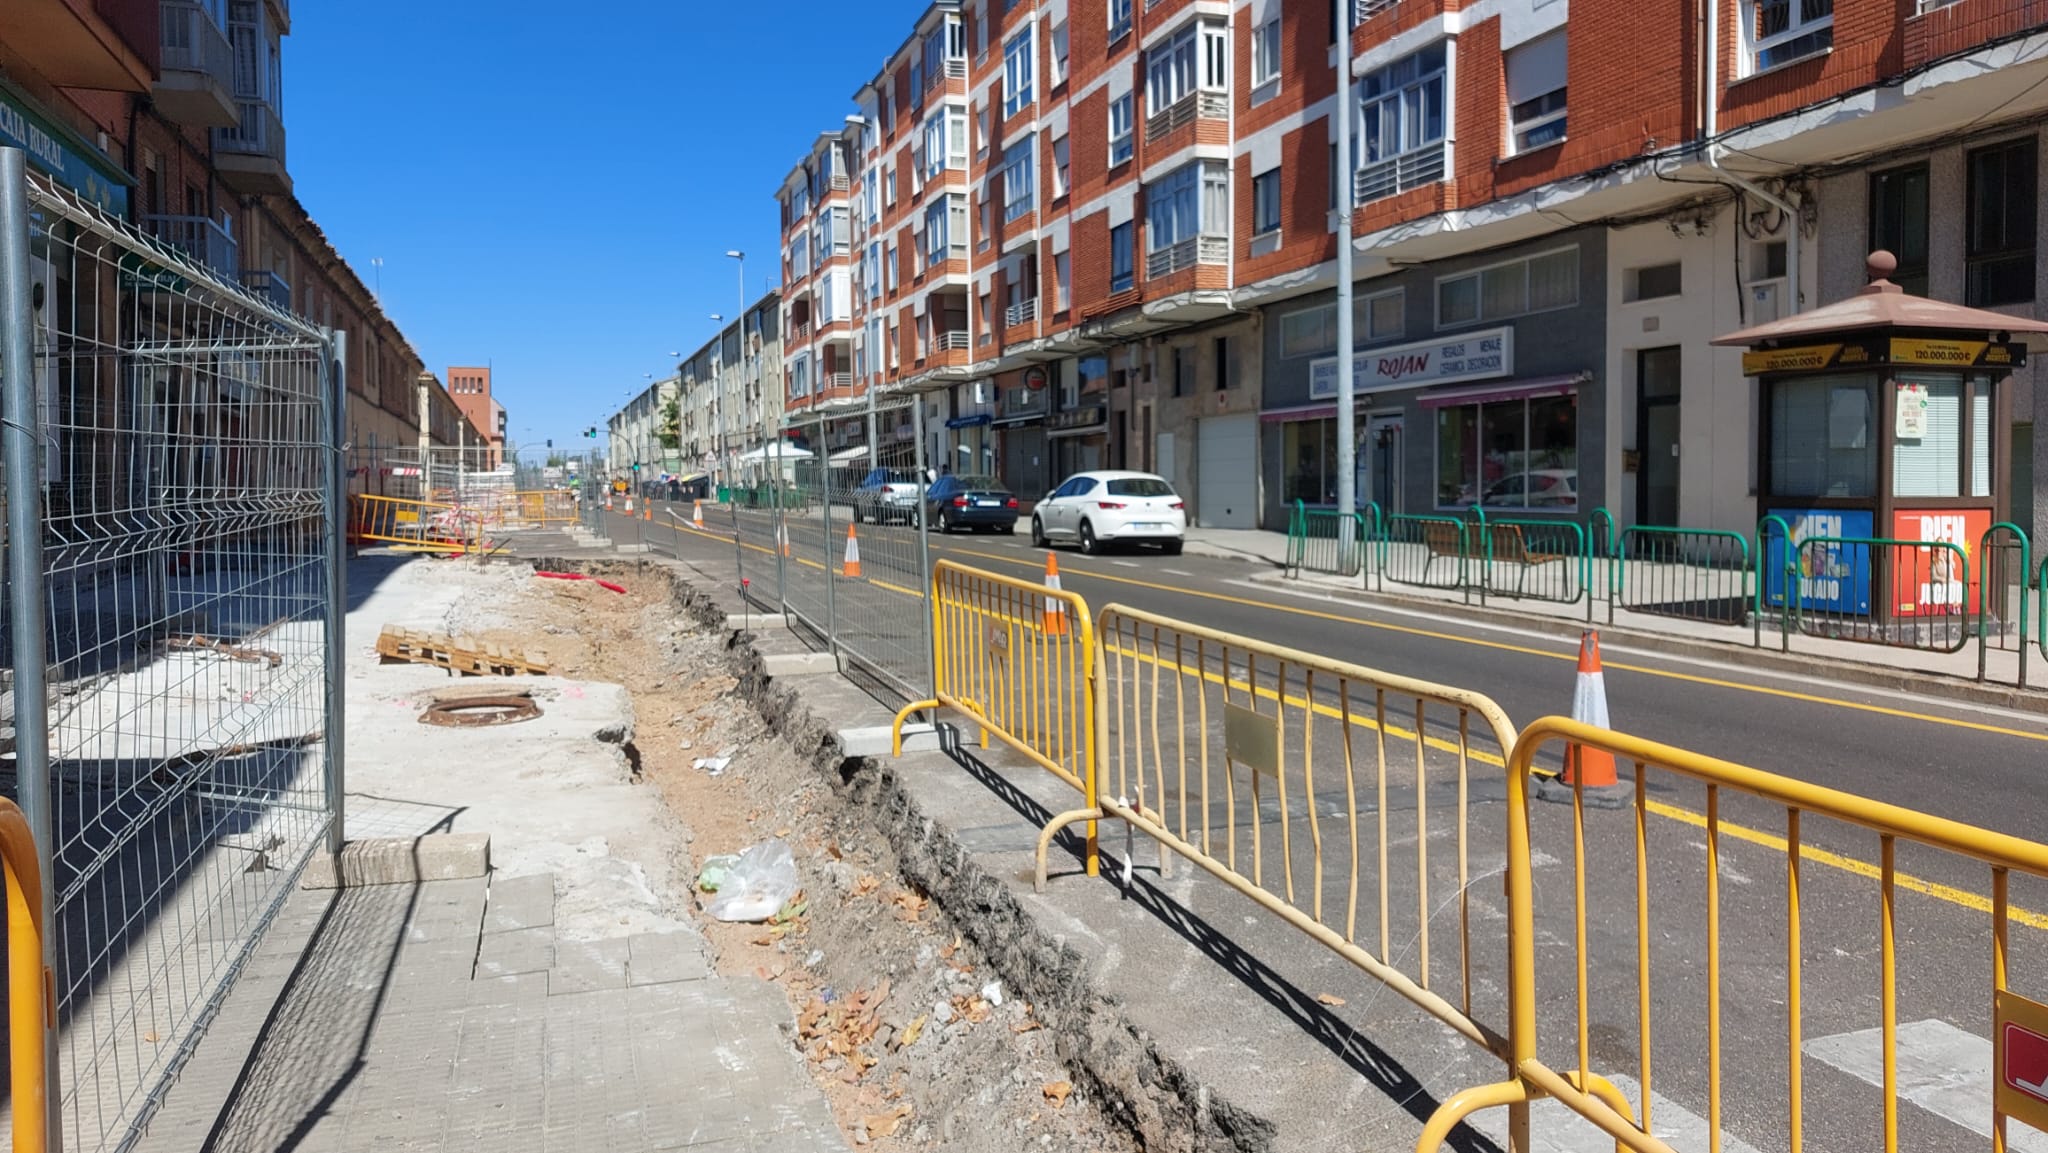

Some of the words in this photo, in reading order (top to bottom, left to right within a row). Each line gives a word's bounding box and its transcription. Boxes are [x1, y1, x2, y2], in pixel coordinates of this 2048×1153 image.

[0, 102, 27, 146] CAJA
[29, 122, 65, 173] RURAL
[1377, 352, 1430, 379] ROJAN
[1920, 515, 1965, 553] BIEN
[1798, 578, 1839, 601] UGADO
